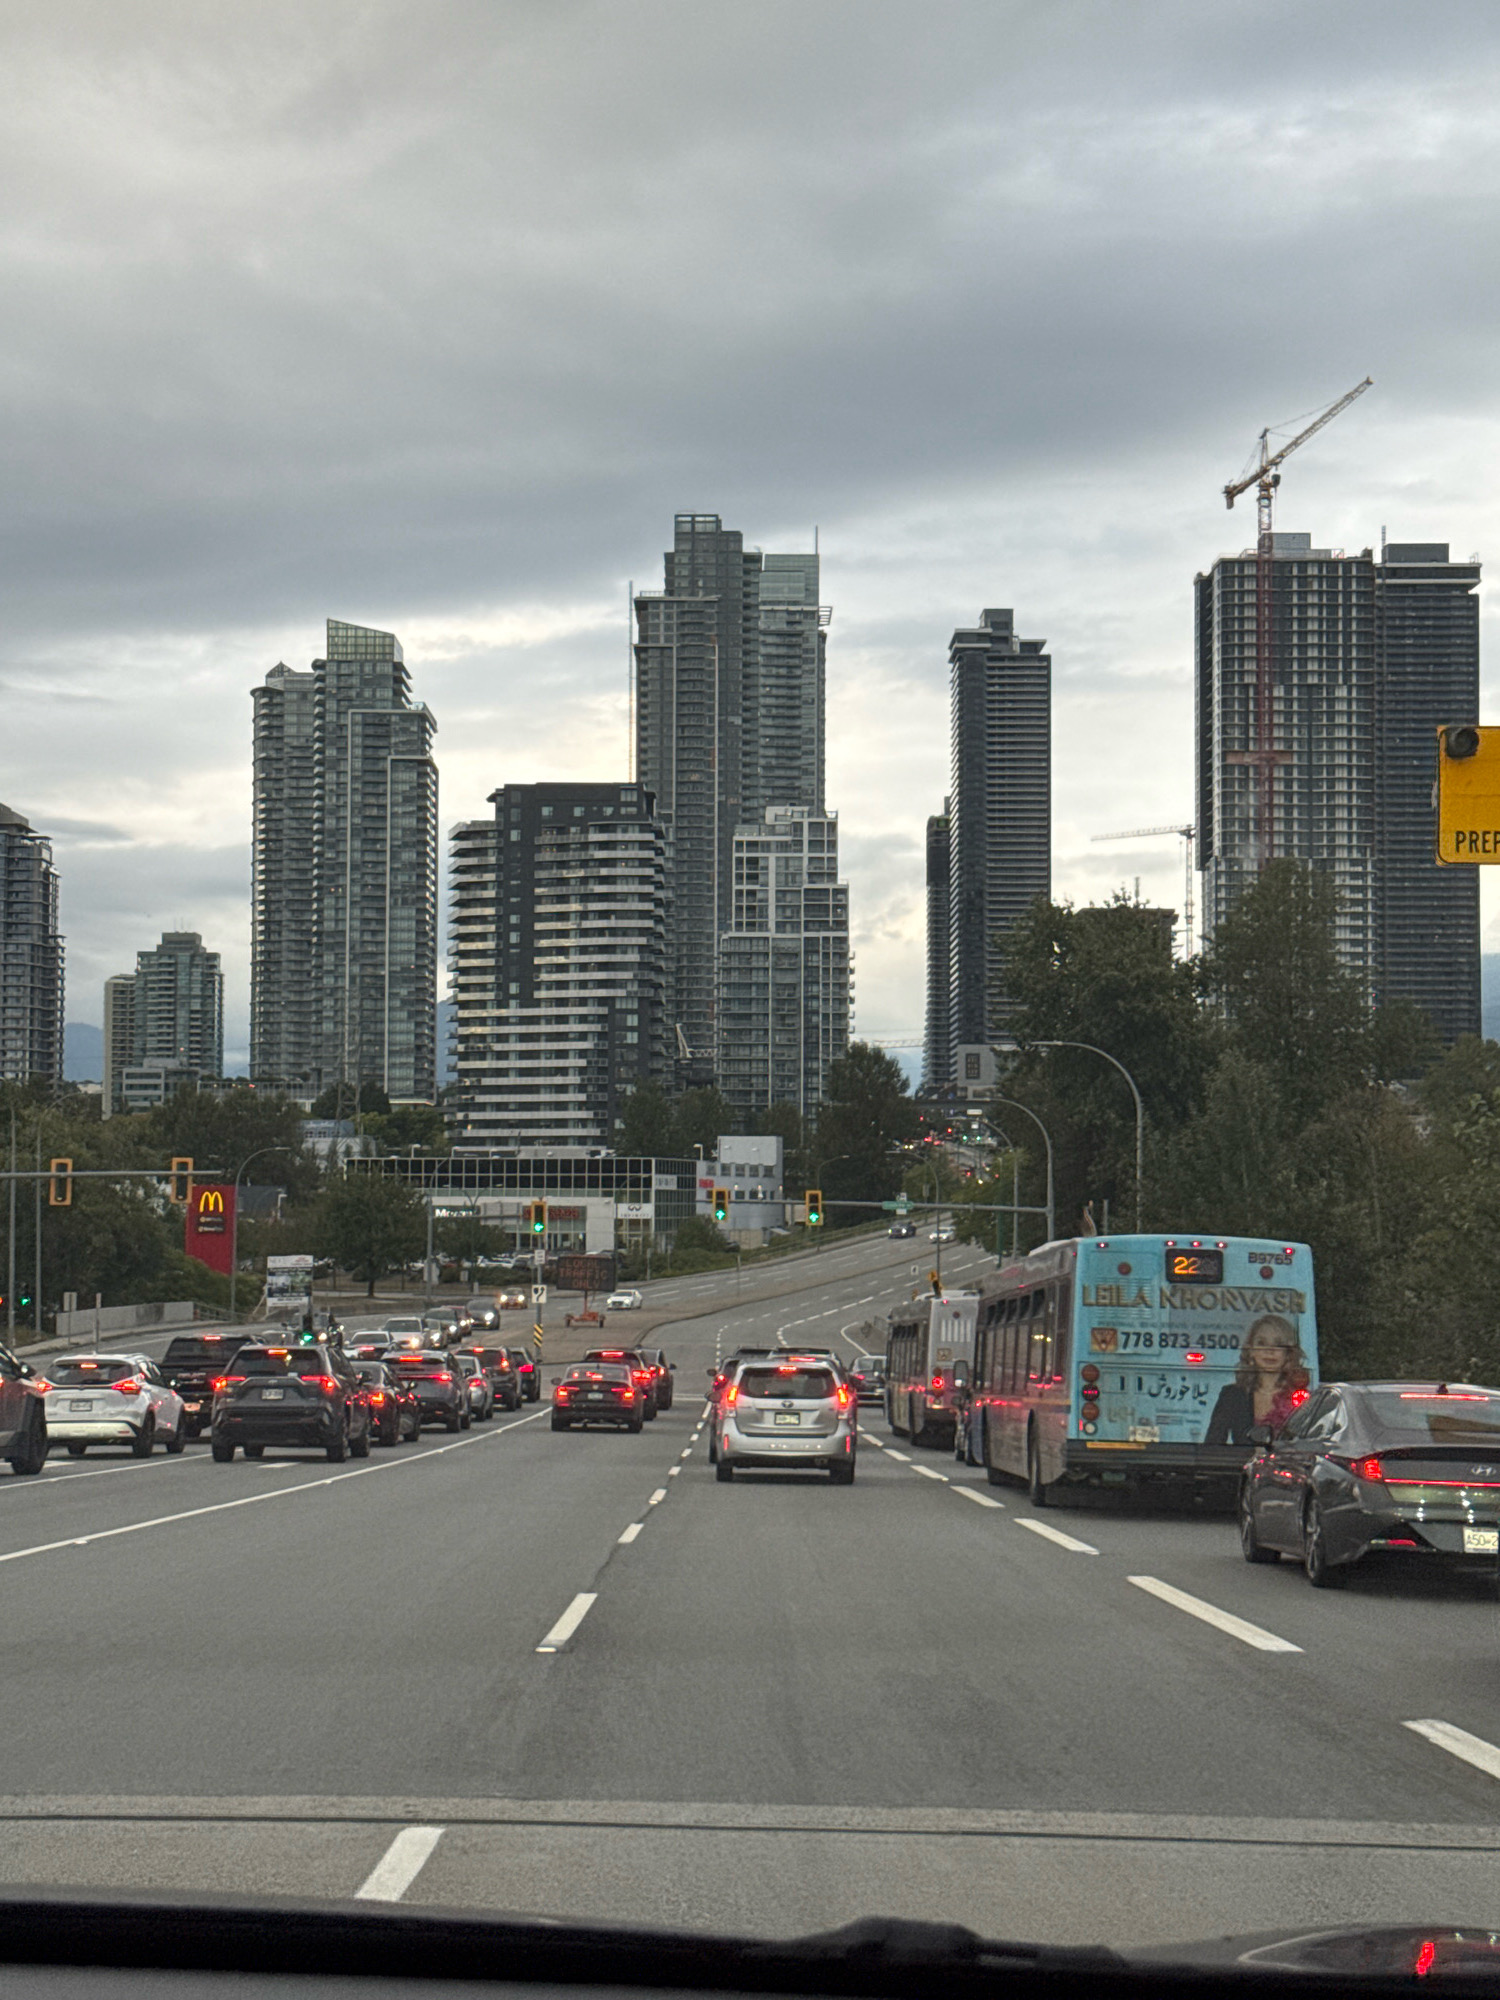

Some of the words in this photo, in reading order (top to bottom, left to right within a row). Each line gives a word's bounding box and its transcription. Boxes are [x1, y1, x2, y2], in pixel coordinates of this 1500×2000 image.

[1247, 1252, 1293, 1266] B9765
[559, 1268, 609, 1280] TRAFFIC
[572, 1279, 601, 1289] ONLY
[1082, 1283, 1153, 1308] LEILA
[1121, 1331, 1154, 1350] 778
[1159, 1332, 1191, 1349] 873
[1196, 1333, 1240, 1350] 4500
